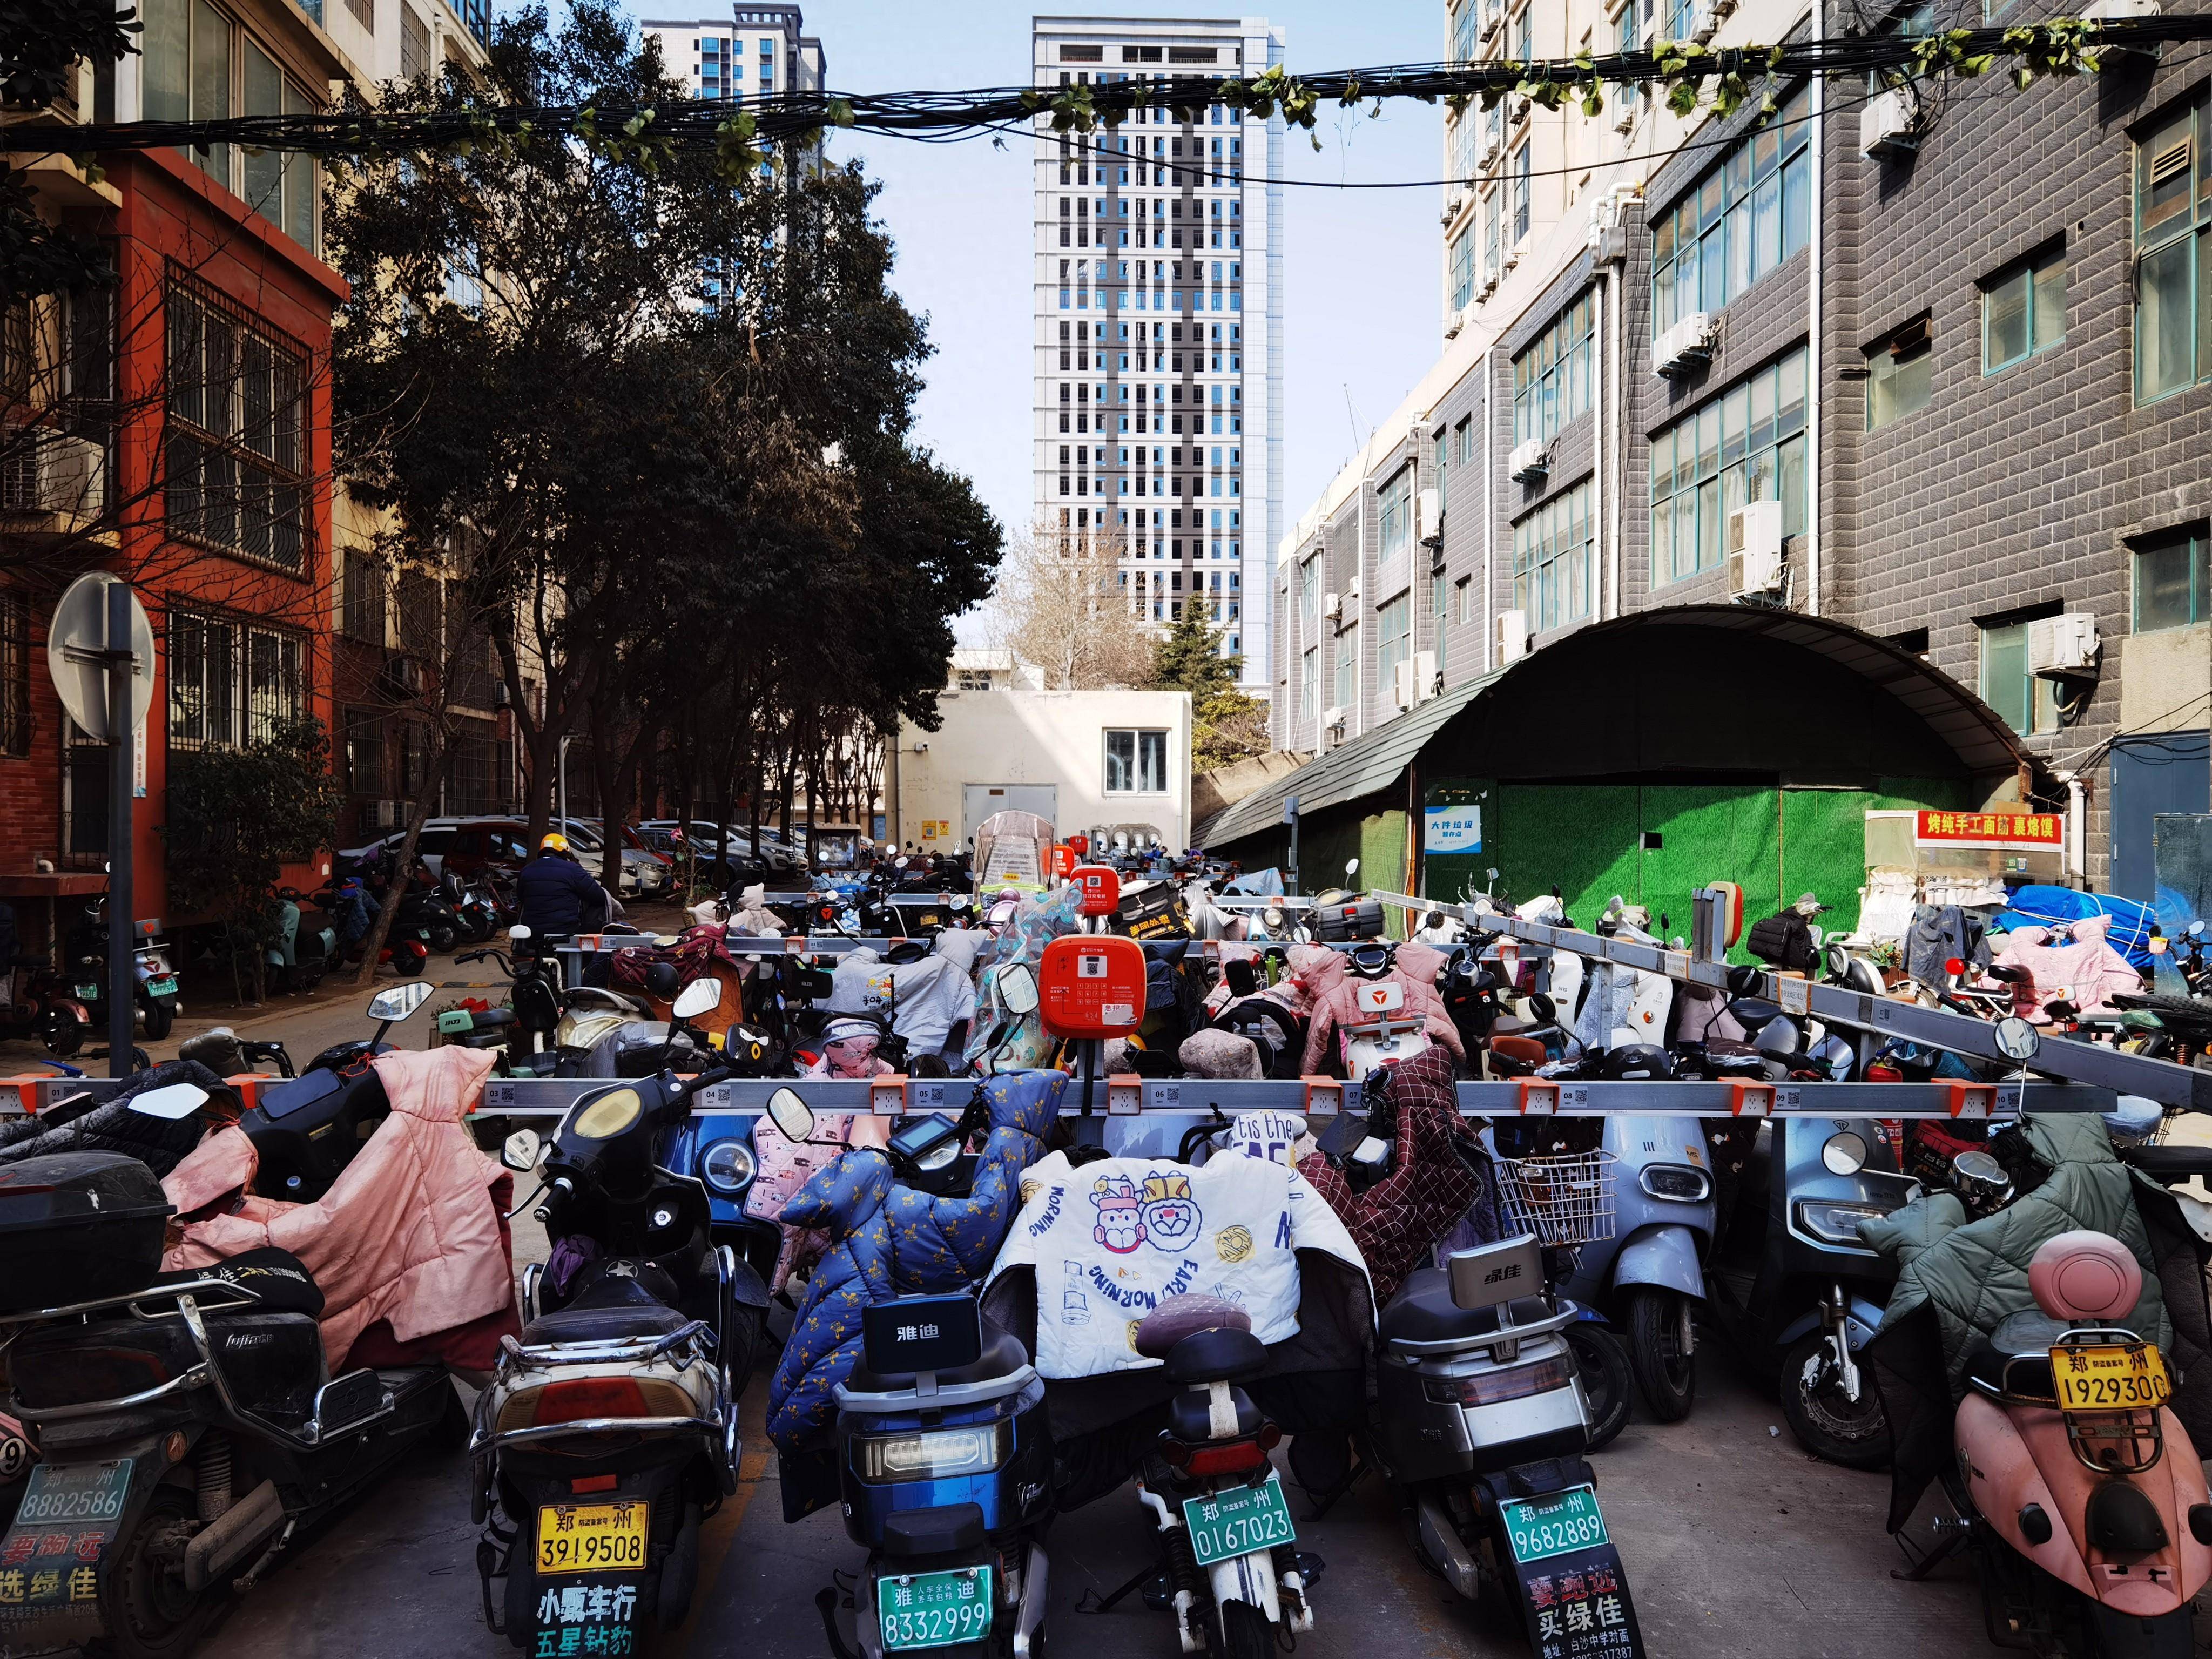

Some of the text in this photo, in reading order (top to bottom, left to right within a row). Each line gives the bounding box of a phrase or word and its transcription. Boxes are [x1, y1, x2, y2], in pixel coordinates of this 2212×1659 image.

[1431, 820, 1473, 830] 大件垃圾
[1129, 914, 1170, 936] 美团外卖
[1265, 1114, 1292, 1141] the
[1484, 1264, 1521, 1284] 绿佳
[896, 1324, 940, 1342] 雅迪
[2069, 1356, 2088, 1373] 郑
[2129, 1352, 2149, 1371] 州
[2065, 1374, 2167, 1404] 1929300
[23, 1489, 118, 1518] 8882586
[1202, 1489, 1271, 1522] 郑 防盗备案号 州
[1518, 1506, 1536, 1523] 郑
[1567, 1495, 1585, 1514] 州
[556, 1515, 573, 1532] 郑
[613, 1512, 631, 1529] 州
[1197, 1510, 1289, 1556] 0167023
[1515, 1515, 1600, 1555] 9682889
[543, 1535, 641, 1566] 3919508
[0, 1567, 98, 1603] 选绿佳
[895, 1589, 913, 1607] 雅
[957, 1580, 975, 1600] 迪
[885, 1602, 986, 1644] 8332999
[1537, 1595, 1625, 1641] 买绿佳
[535, 1624, 632, 1658] 五星钻豹
[1571, 1628, 1629, 1653] 白沙中学对面
[1572, 1646, 1631, 1659] 517387
